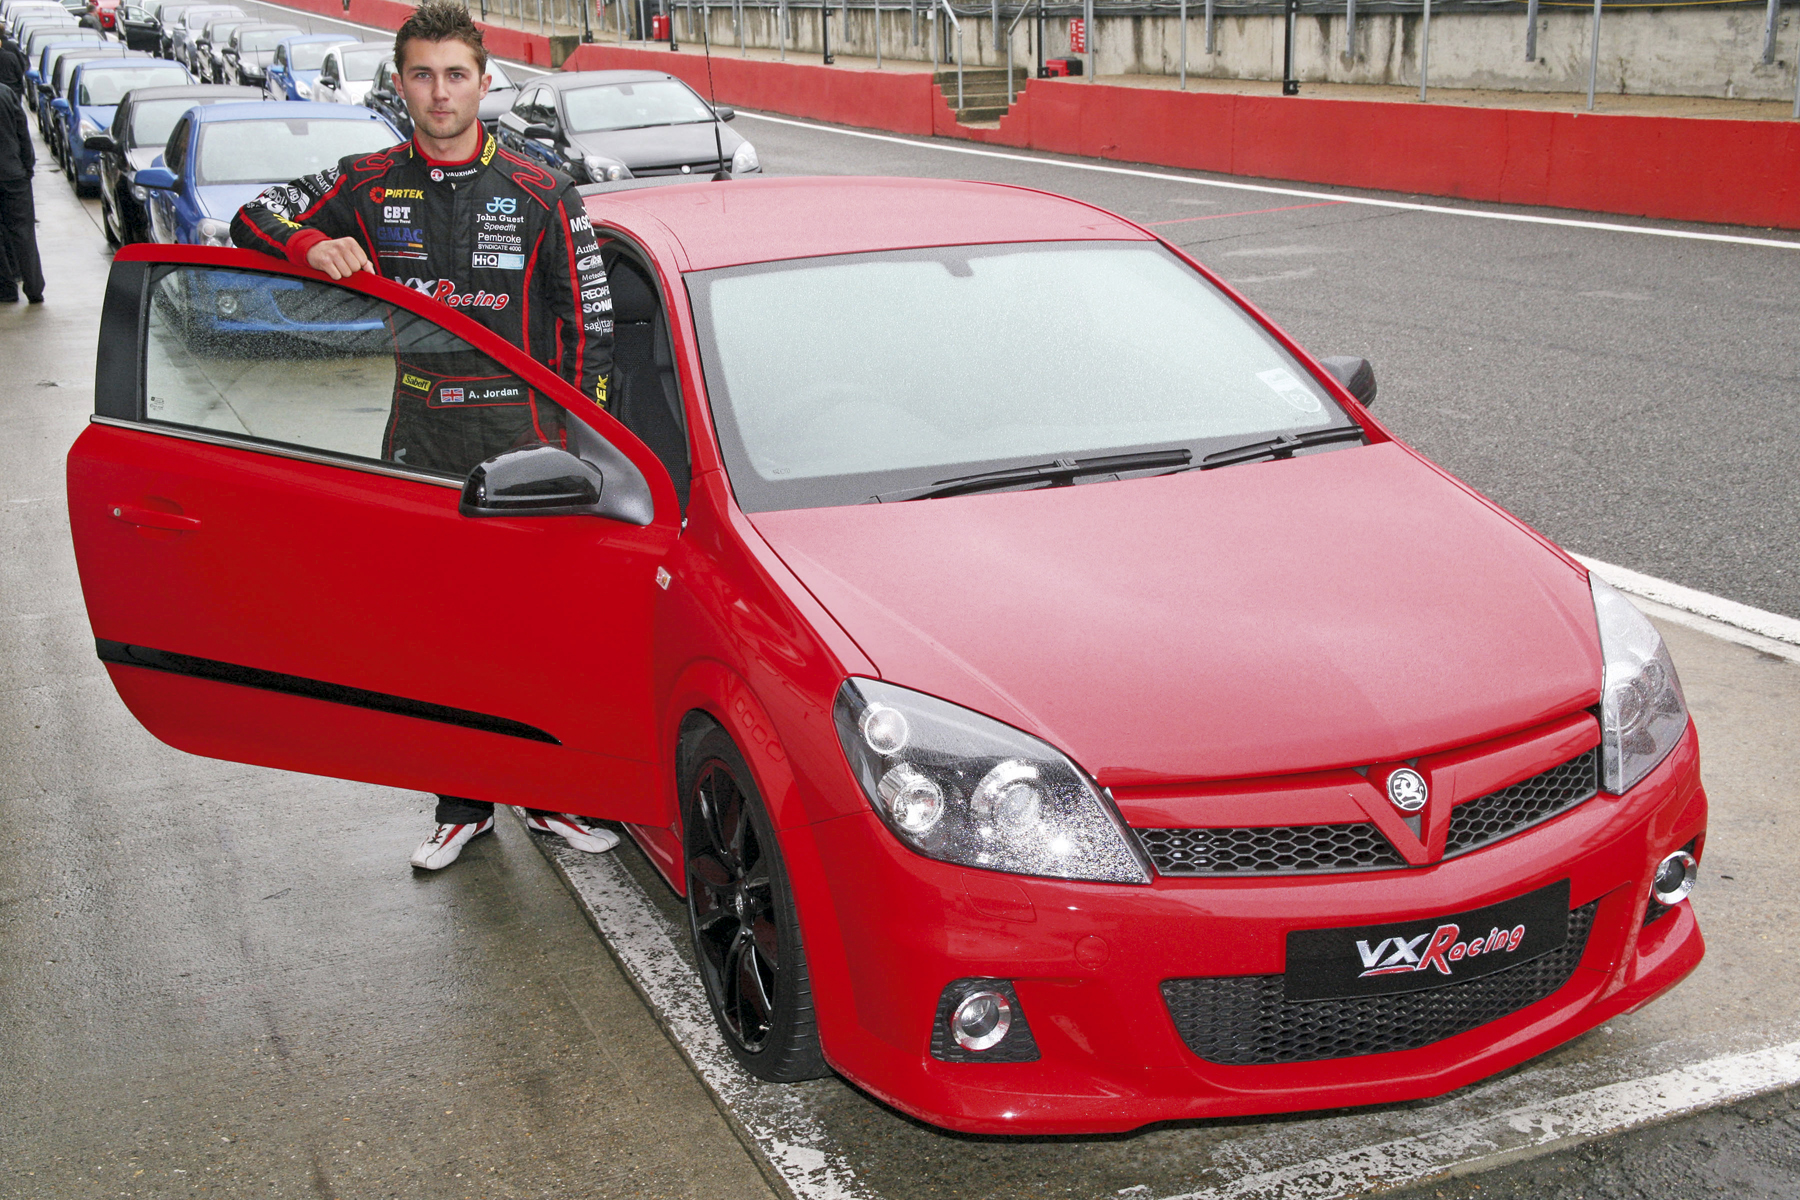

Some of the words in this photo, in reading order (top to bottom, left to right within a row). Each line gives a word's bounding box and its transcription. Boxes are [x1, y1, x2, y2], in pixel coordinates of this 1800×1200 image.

[445, 168, 478, 177] VAUXHALL
[384, 188, 425, 200] PIRTEK
[383, 205, 411, 219] CBT
[476, 213, 497, 223] John
[498, 214, 525, 223] Guest
[483, 222, 517, 232] Speedfit
[376, 226, 424, 243] GMAC
[477, 232, 522, 244] Pembroke
[477, 243, 508, 252] SYNDICATE
[474, 254, 498, 267] HiQ
[468, 390, 480, 399] A.
[483, 388, 519, 399] Jordan
